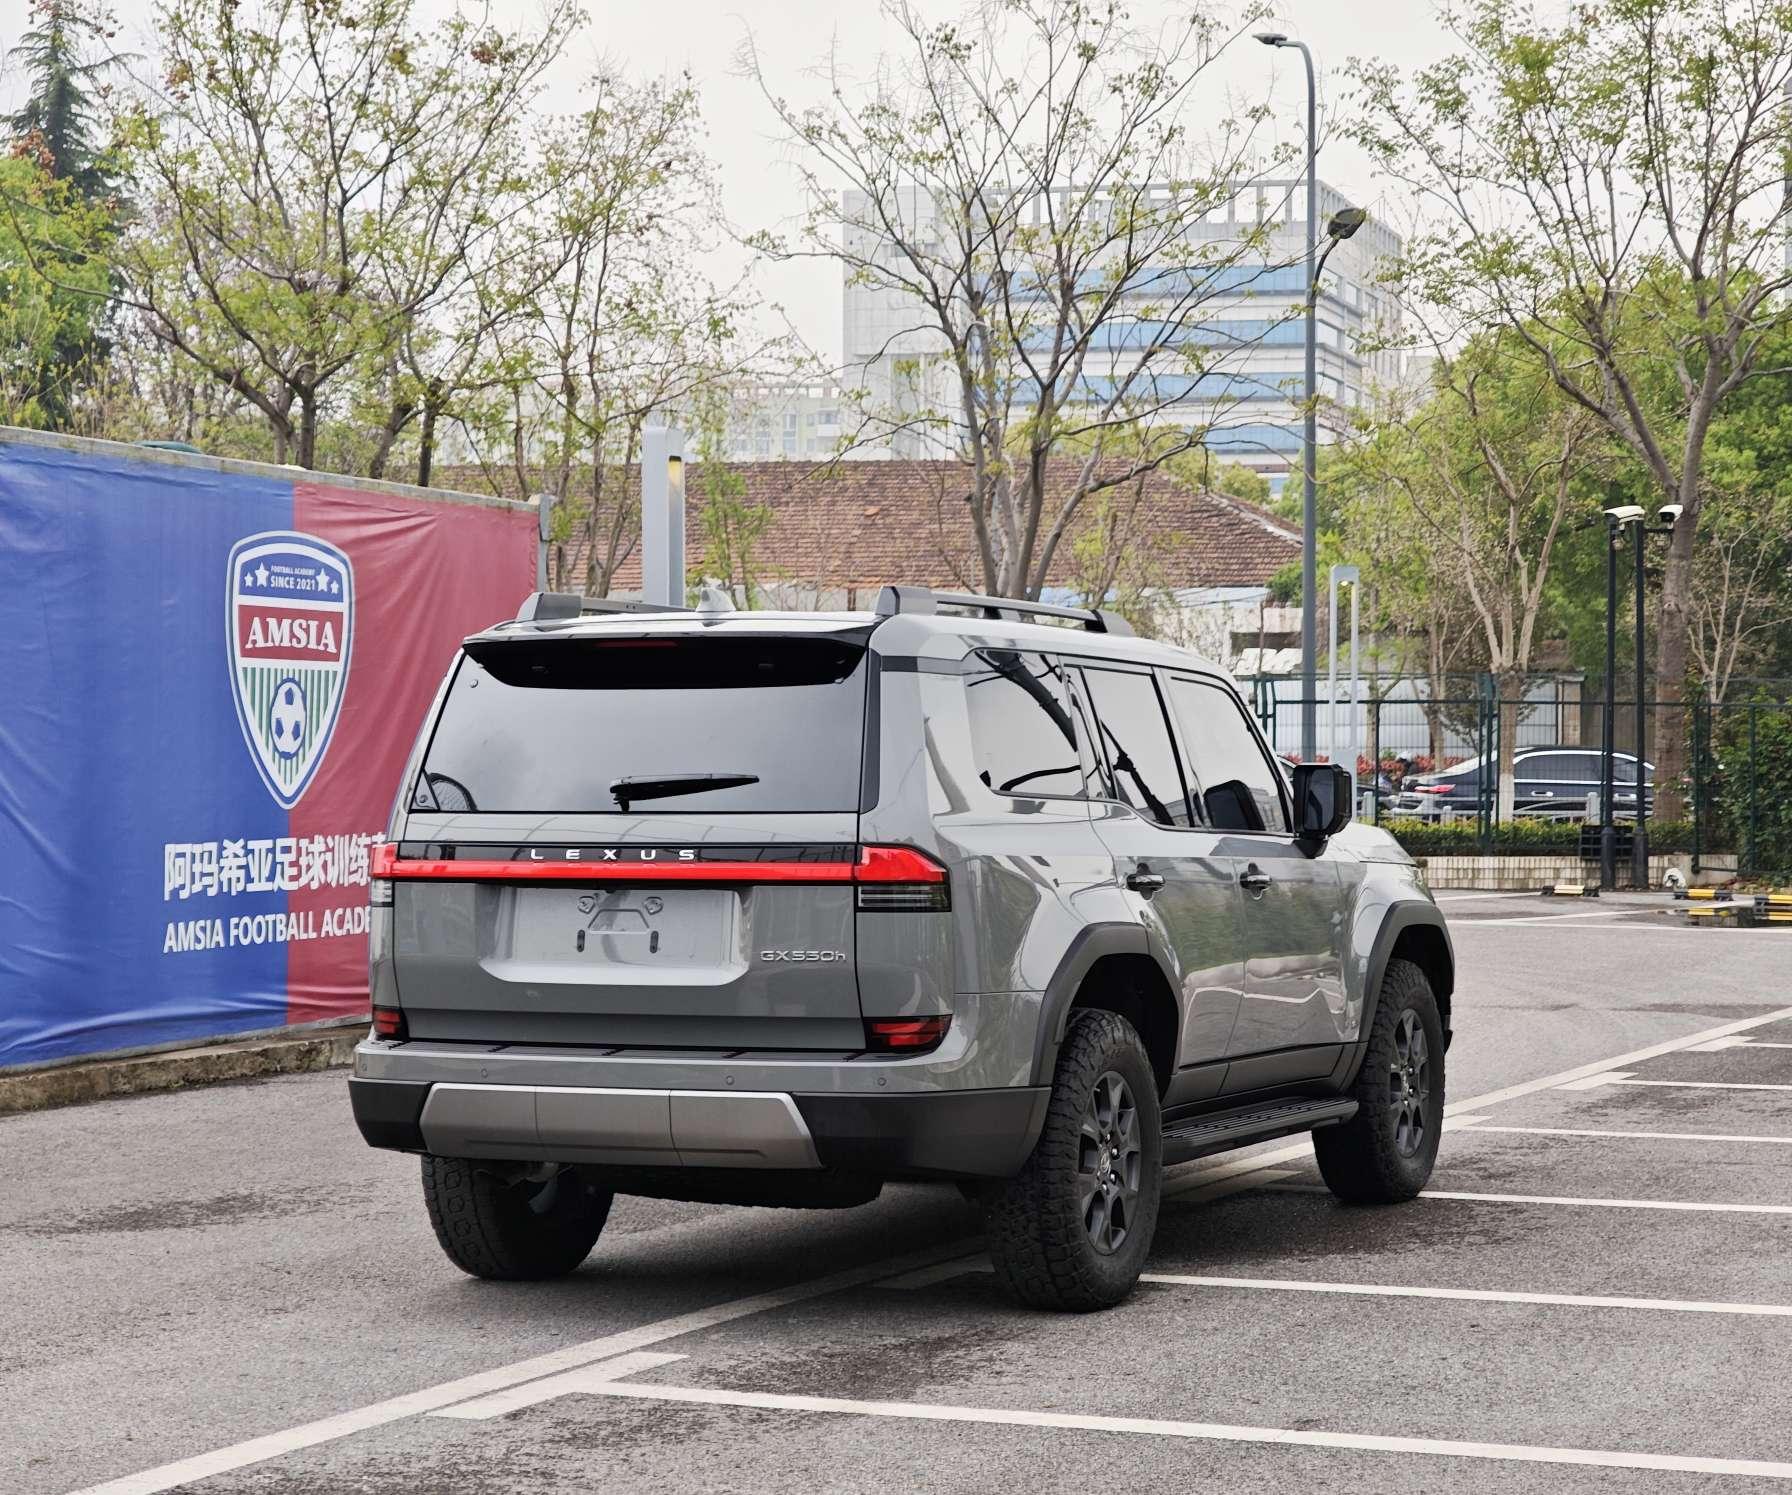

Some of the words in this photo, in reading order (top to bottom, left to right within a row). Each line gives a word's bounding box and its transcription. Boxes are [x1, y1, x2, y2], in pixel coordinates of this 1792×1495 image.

[270, 575, 295, 589] SINCE
[296, 578, 316, 591] 2021
[245, 616, 338, 654] AMSIA
[164, 832, 387, 901] 阿玛希亚足球训练
[530, 848, 695, 860] LEXUS
[163, 918, 225, 954] AMSIA
[229, 911, 317, 947] FOOTBALL
